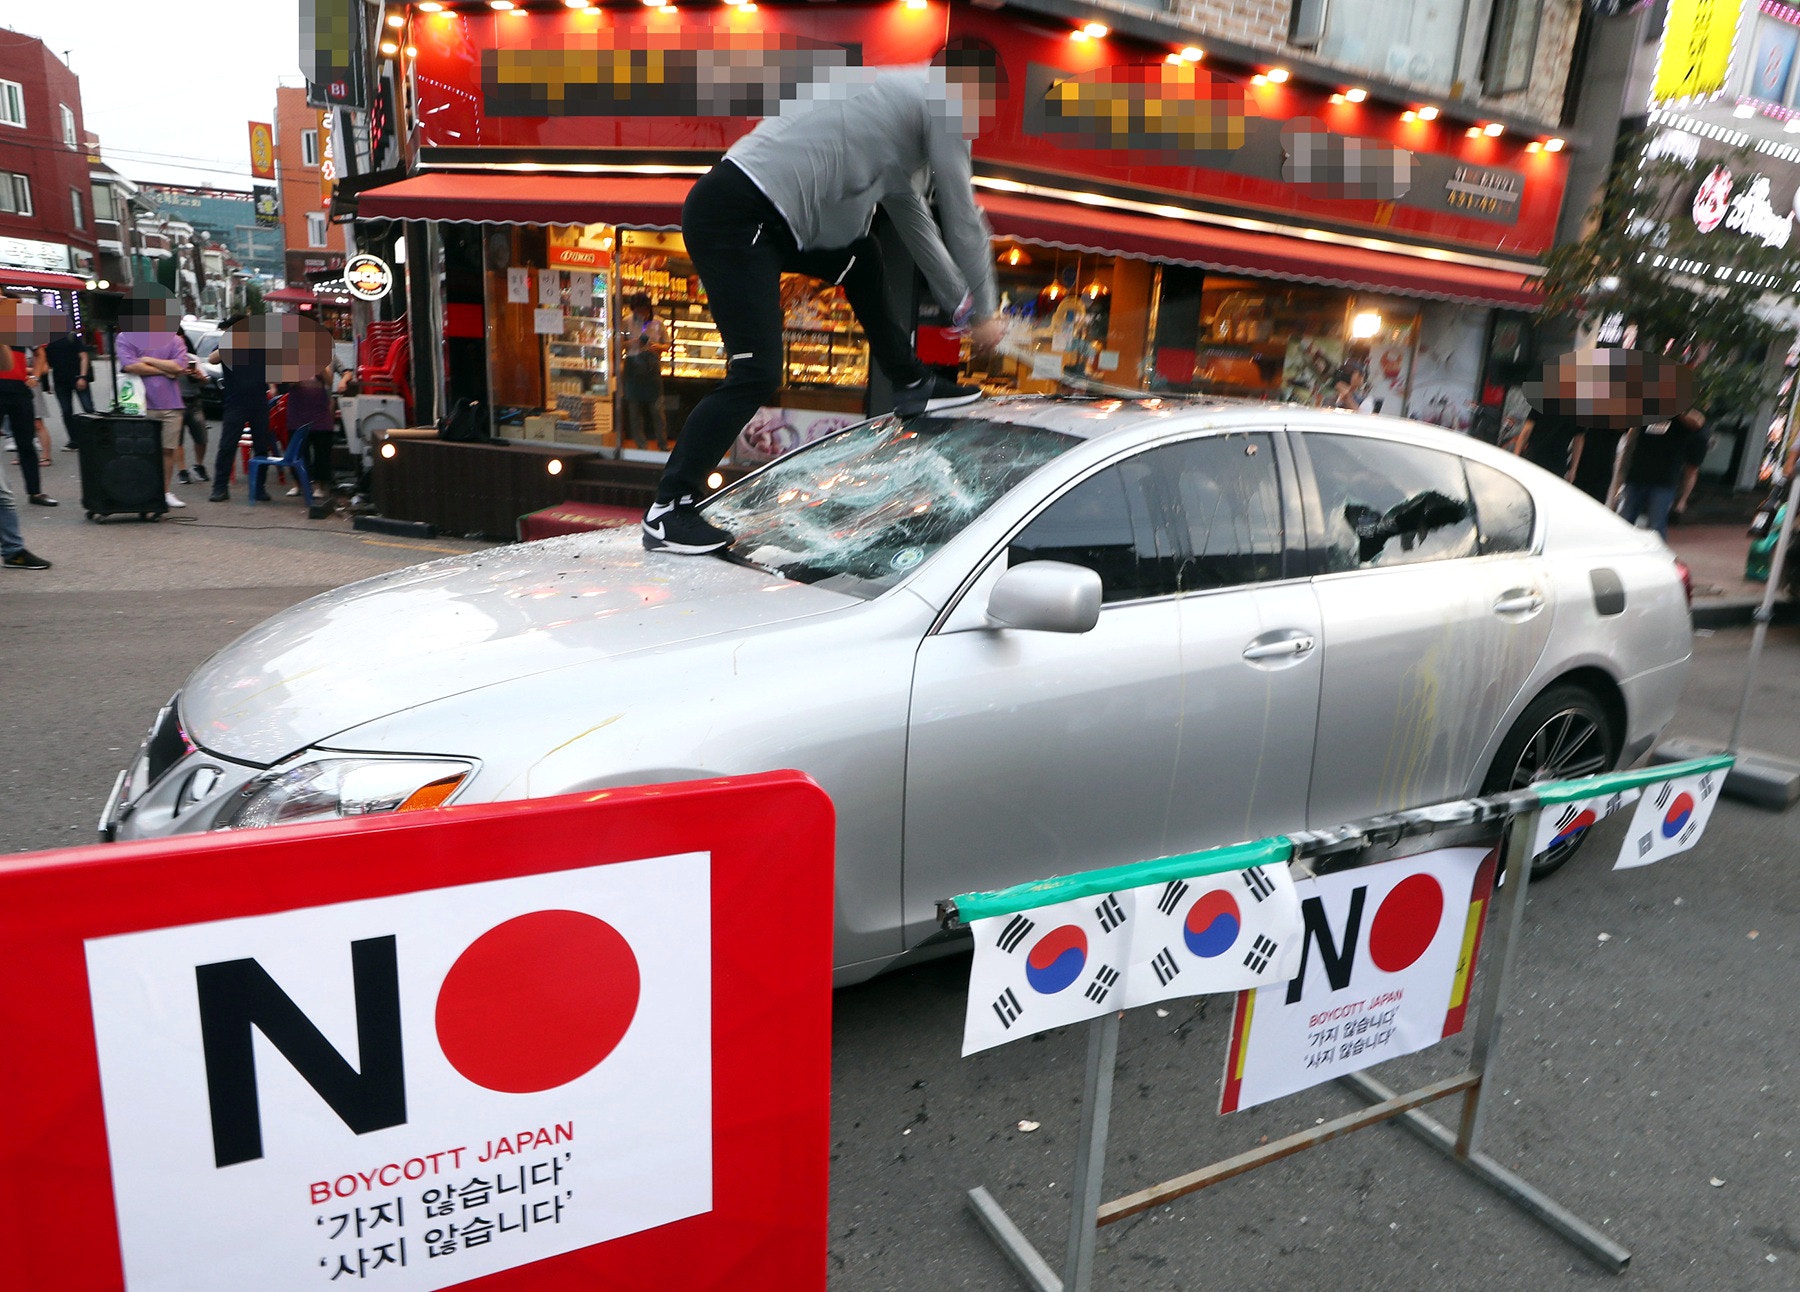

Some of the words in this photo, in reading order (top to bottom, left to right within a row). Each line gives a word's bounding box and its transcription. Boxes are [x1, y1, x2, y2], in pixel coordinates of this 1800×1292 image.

[1308, 999, 1366, 1028] BOYCOTT
[1367, 987, 1404, 1011] JAPAN
[309, 1146, 468, 1206] BOYCOTT
[478, 1120, 574, 1164] JAPAN
